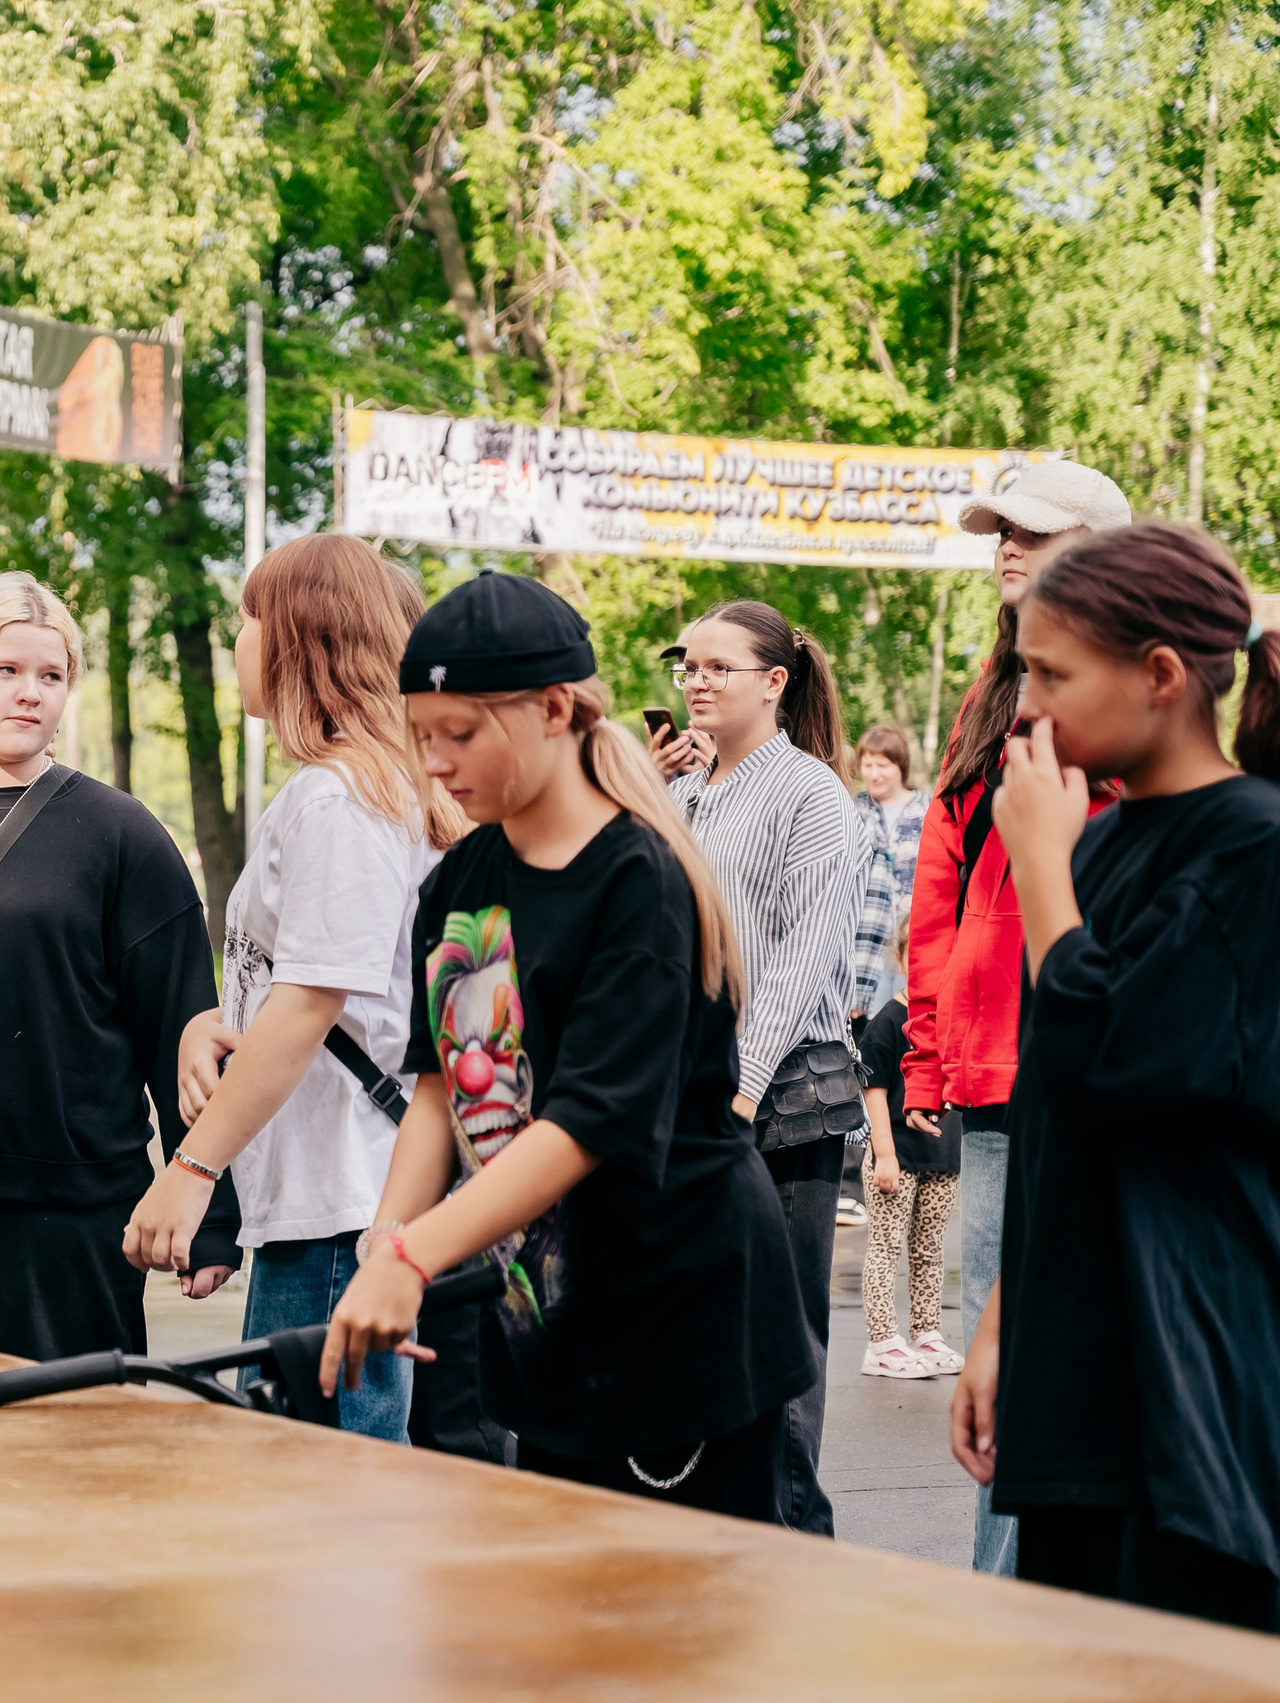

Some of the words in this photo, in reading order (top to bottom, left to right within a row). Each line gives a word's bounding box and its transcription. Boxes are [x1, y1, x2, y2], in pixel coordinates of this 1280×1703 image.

[537, 436, 706, 480] СОБИРАЕМ
[713, 450, 834, 490] ЛУЧШЕЕ
[841, 459, 973, 494] ДЕТСКОЕ
[582, 477, 779, 518] КОМЬЮНИТИ
[785, 486, 941, 525] КУЗБАССА
